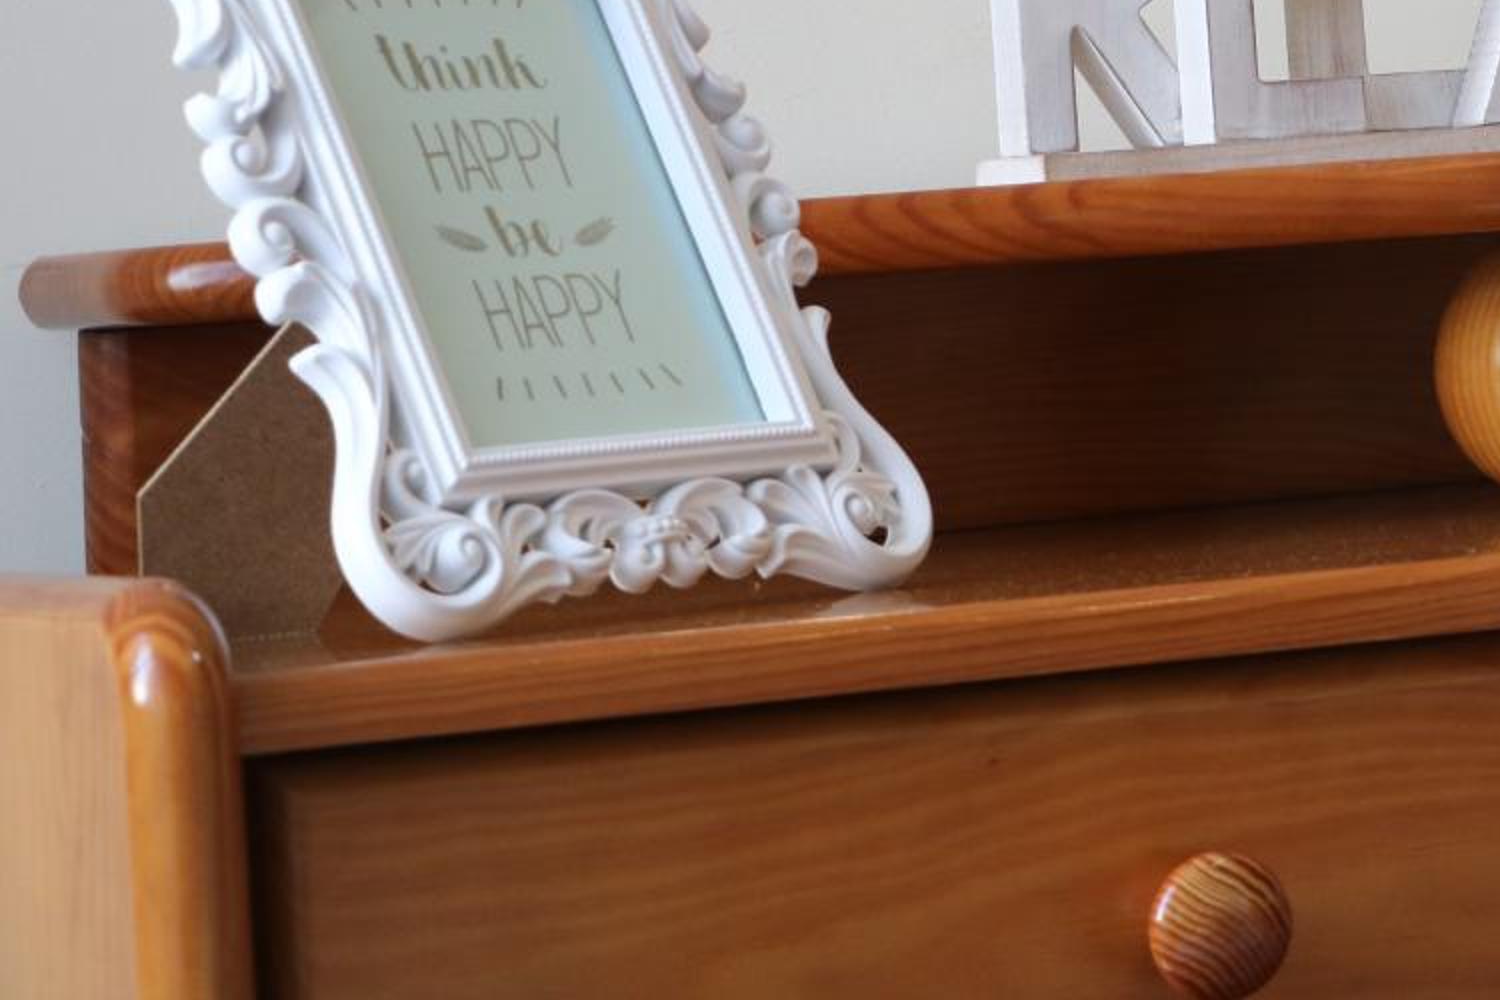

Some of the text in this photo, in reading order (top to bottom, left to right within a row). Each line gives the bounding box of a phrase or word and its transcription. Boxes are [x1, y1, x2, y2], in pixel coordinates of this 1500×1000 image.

[374, 34, 547, 91] think
[411, 117, 573, 194] HAPPY
[484, 205, 562, 258] be
[472, 269, 635, 351] HAPPY
